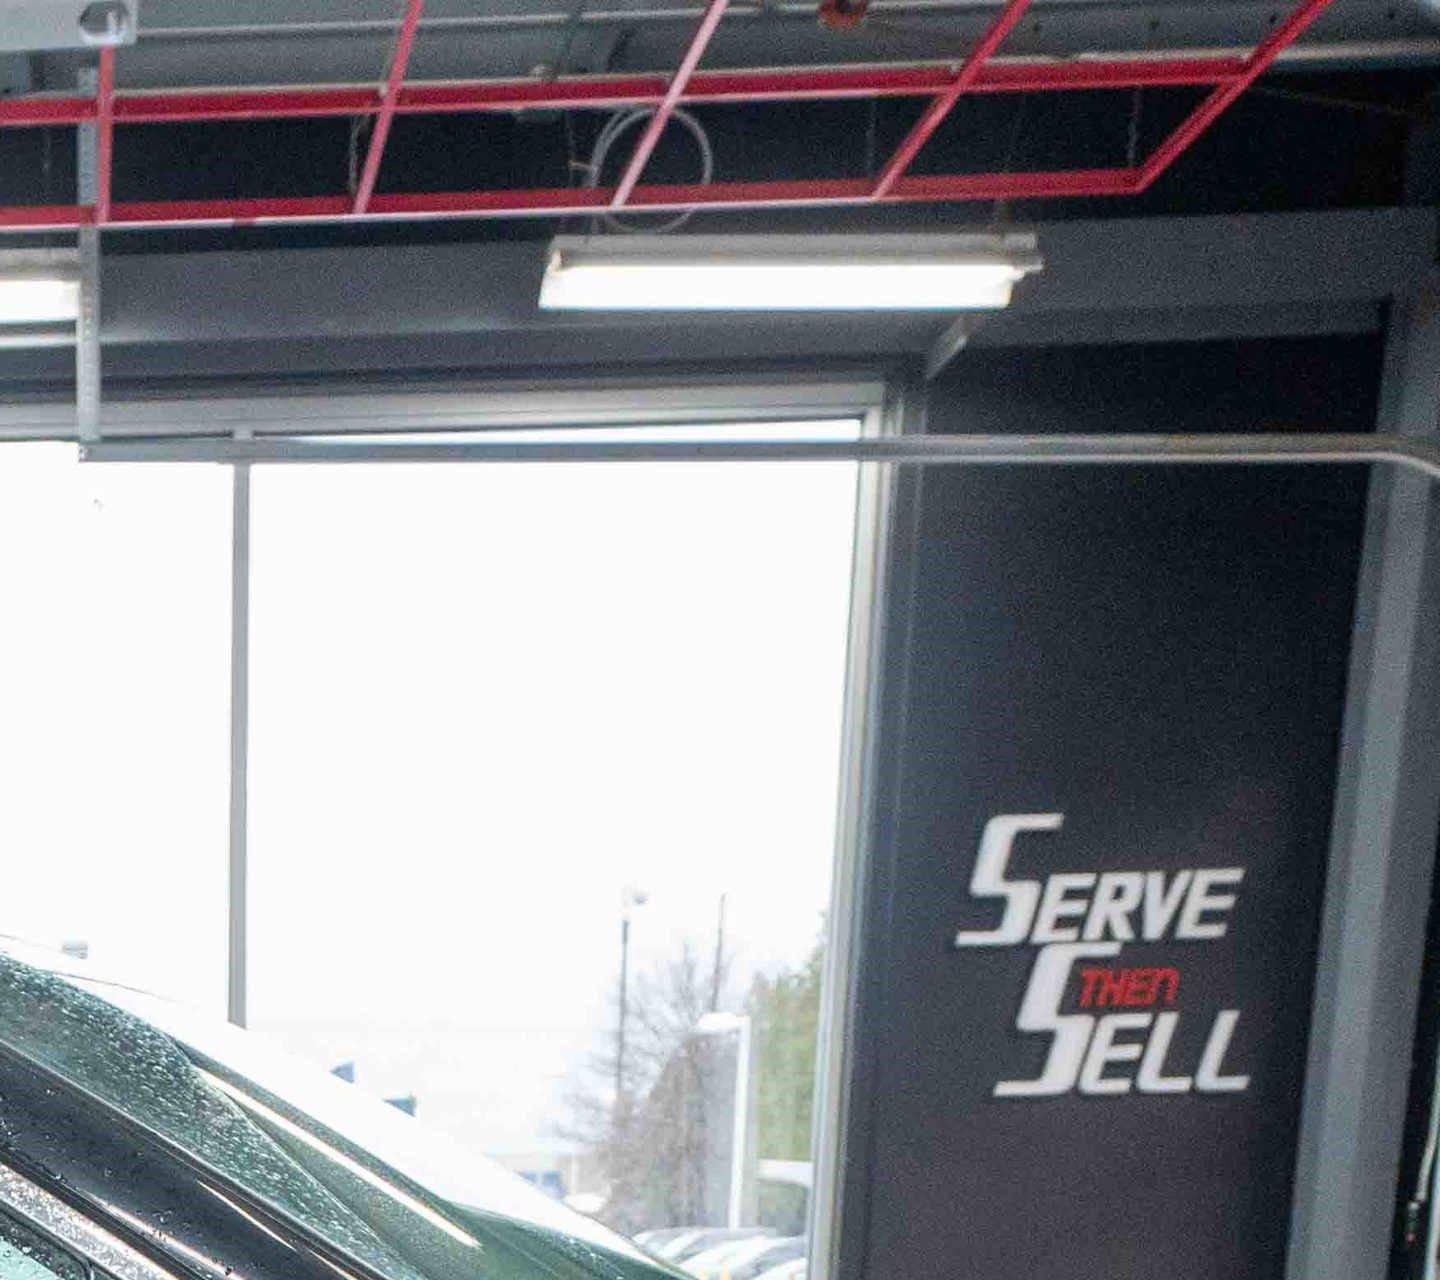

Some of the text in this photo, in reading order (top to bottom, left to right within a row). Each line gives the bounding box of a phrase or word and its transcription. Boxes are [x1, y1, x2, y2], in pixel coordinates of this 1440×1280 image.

[954, 812, 1246, 946] SERVE
[992, 941, 1251, 1097] SELL
[1079, 966, 1180, 1009] THEN
